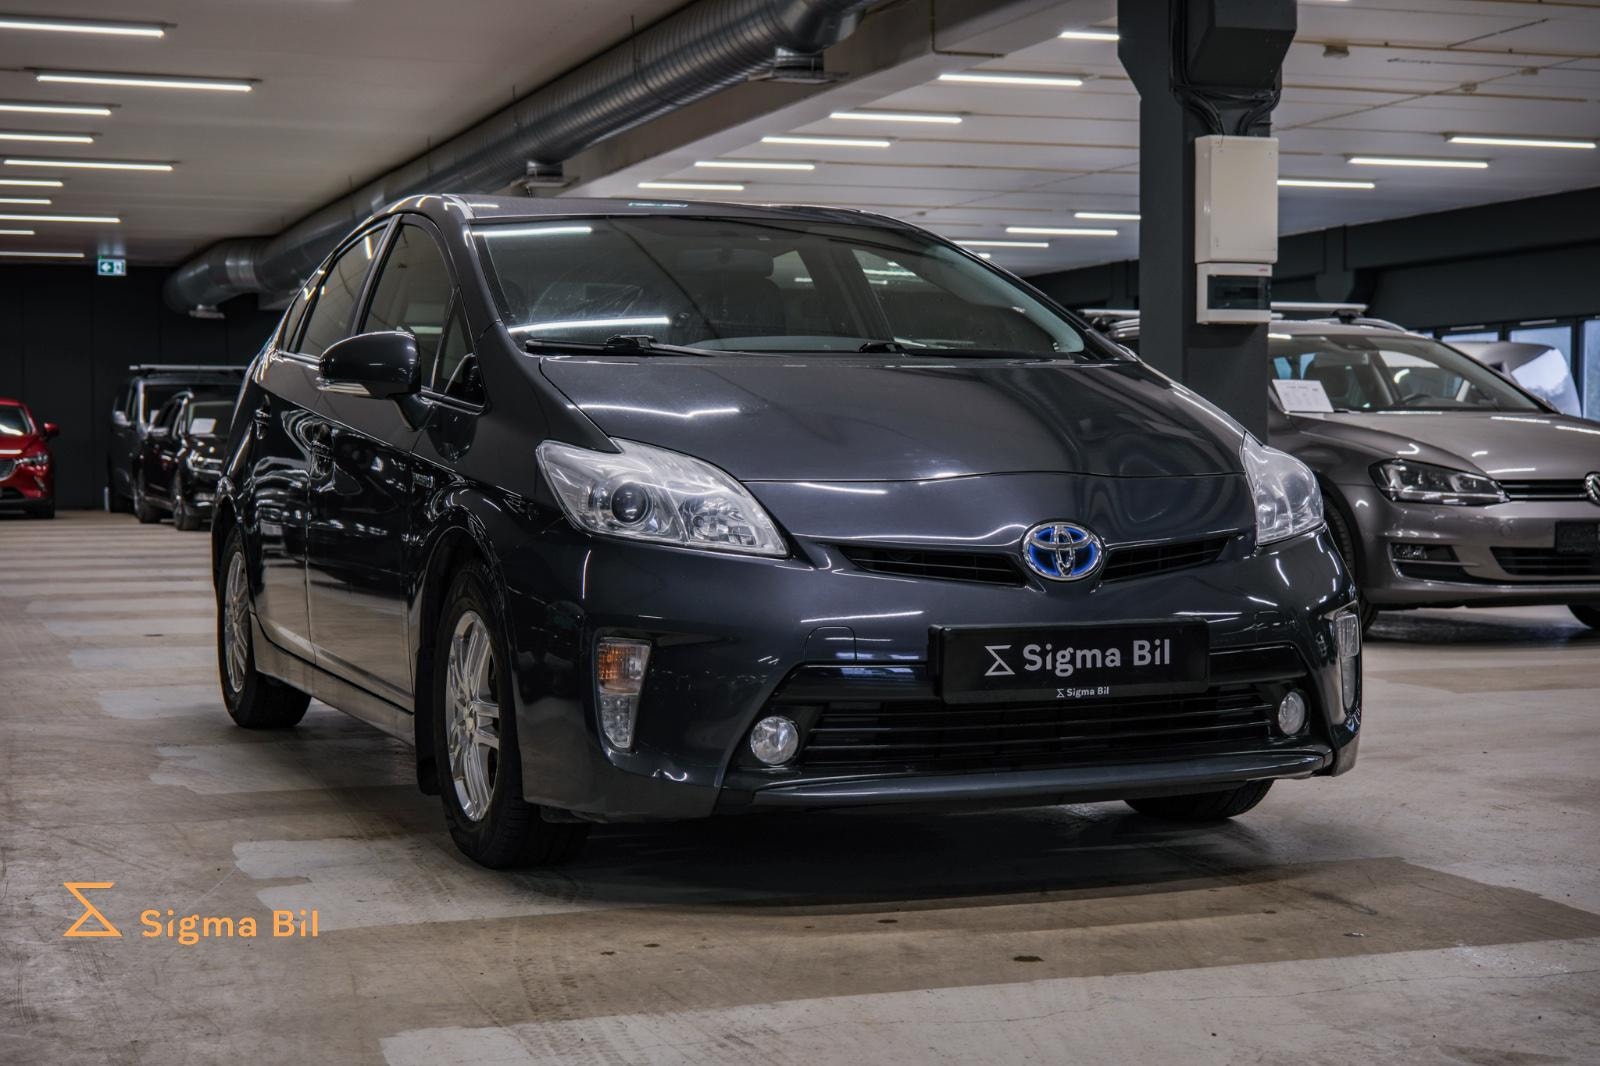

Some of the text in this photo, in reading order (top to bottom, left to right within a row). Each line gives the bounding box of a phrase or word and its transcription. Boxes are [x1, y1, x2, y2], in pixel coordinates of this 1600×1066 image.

[1022, 638, 1170, 677] Sigma Bil
[1066, 686, 1110, 698] Sigma Bil
